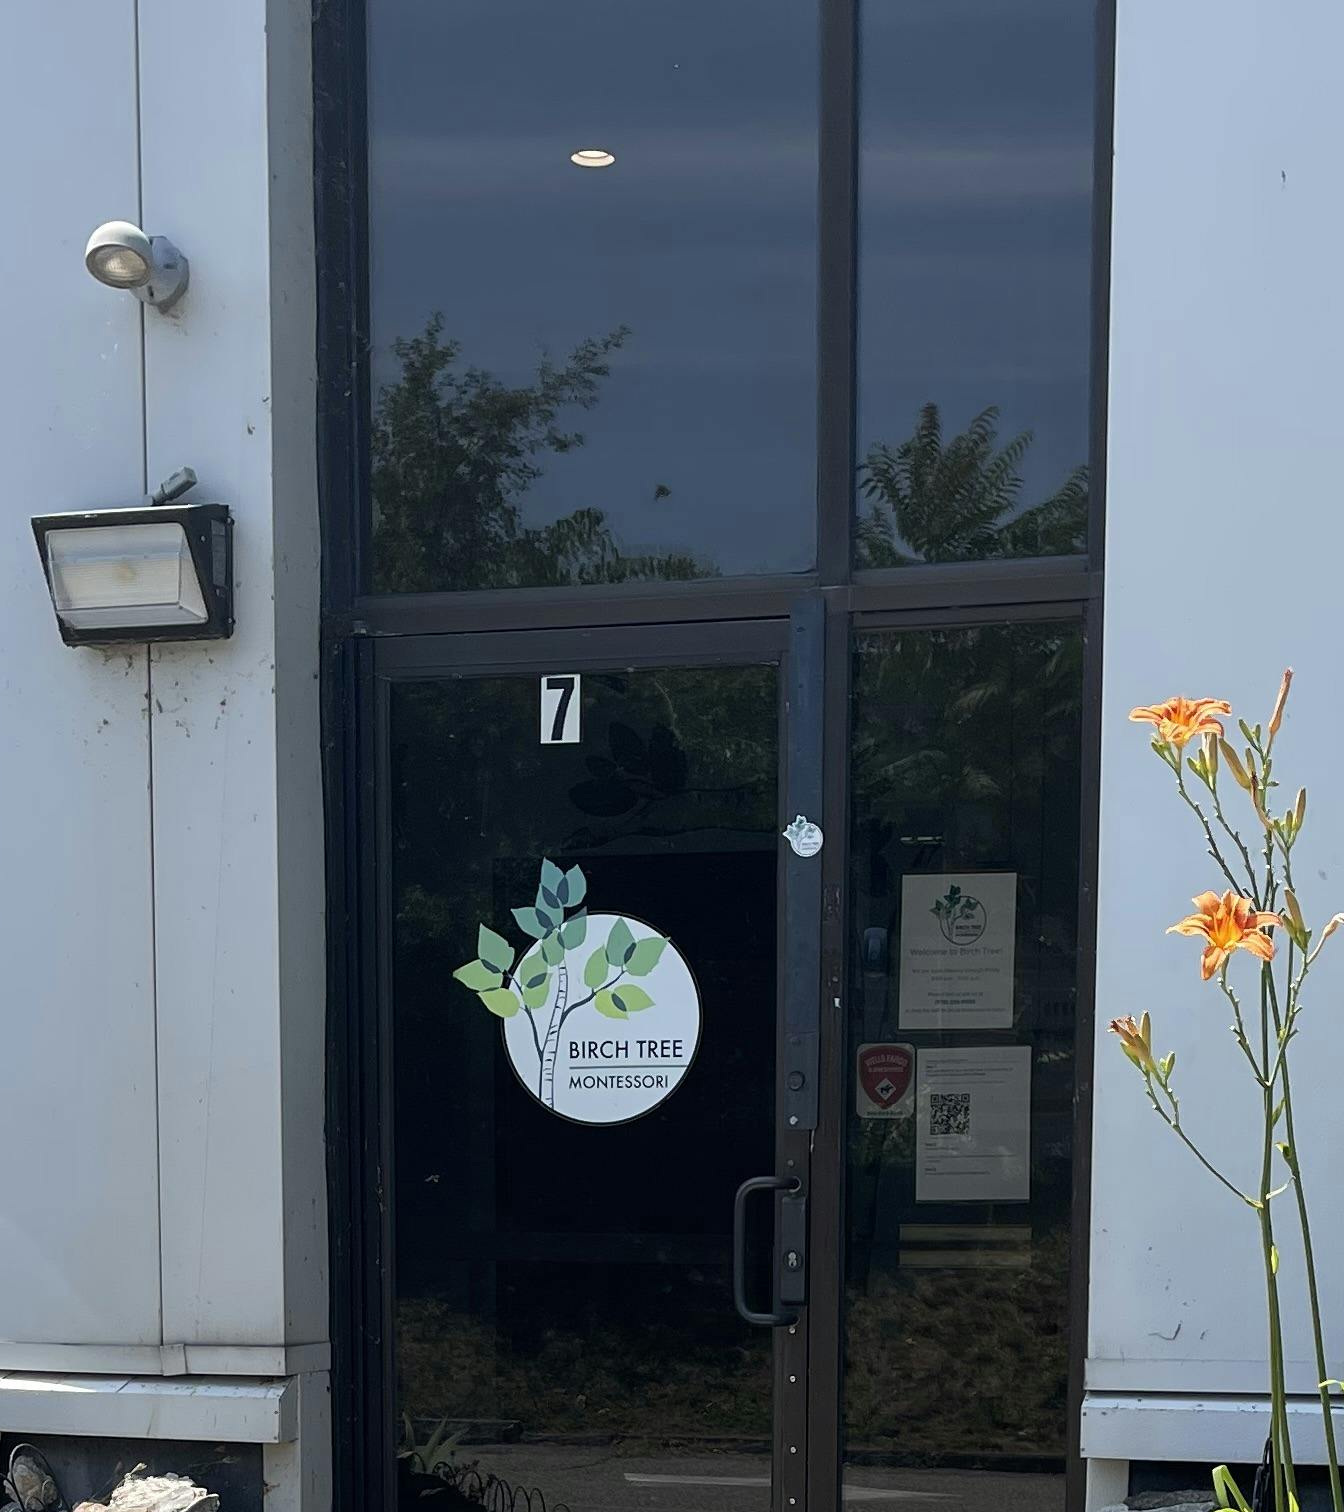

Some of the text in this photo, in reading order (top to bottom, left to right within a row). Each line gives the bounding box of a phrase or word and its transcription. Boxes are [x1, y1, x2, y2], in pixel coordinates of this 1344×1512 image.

[546, 677, 575, 740] 7
[569, 1039, 683, 1059] BIRCH TREE
[569, 1075, 668, 1089] MONTESSORI
